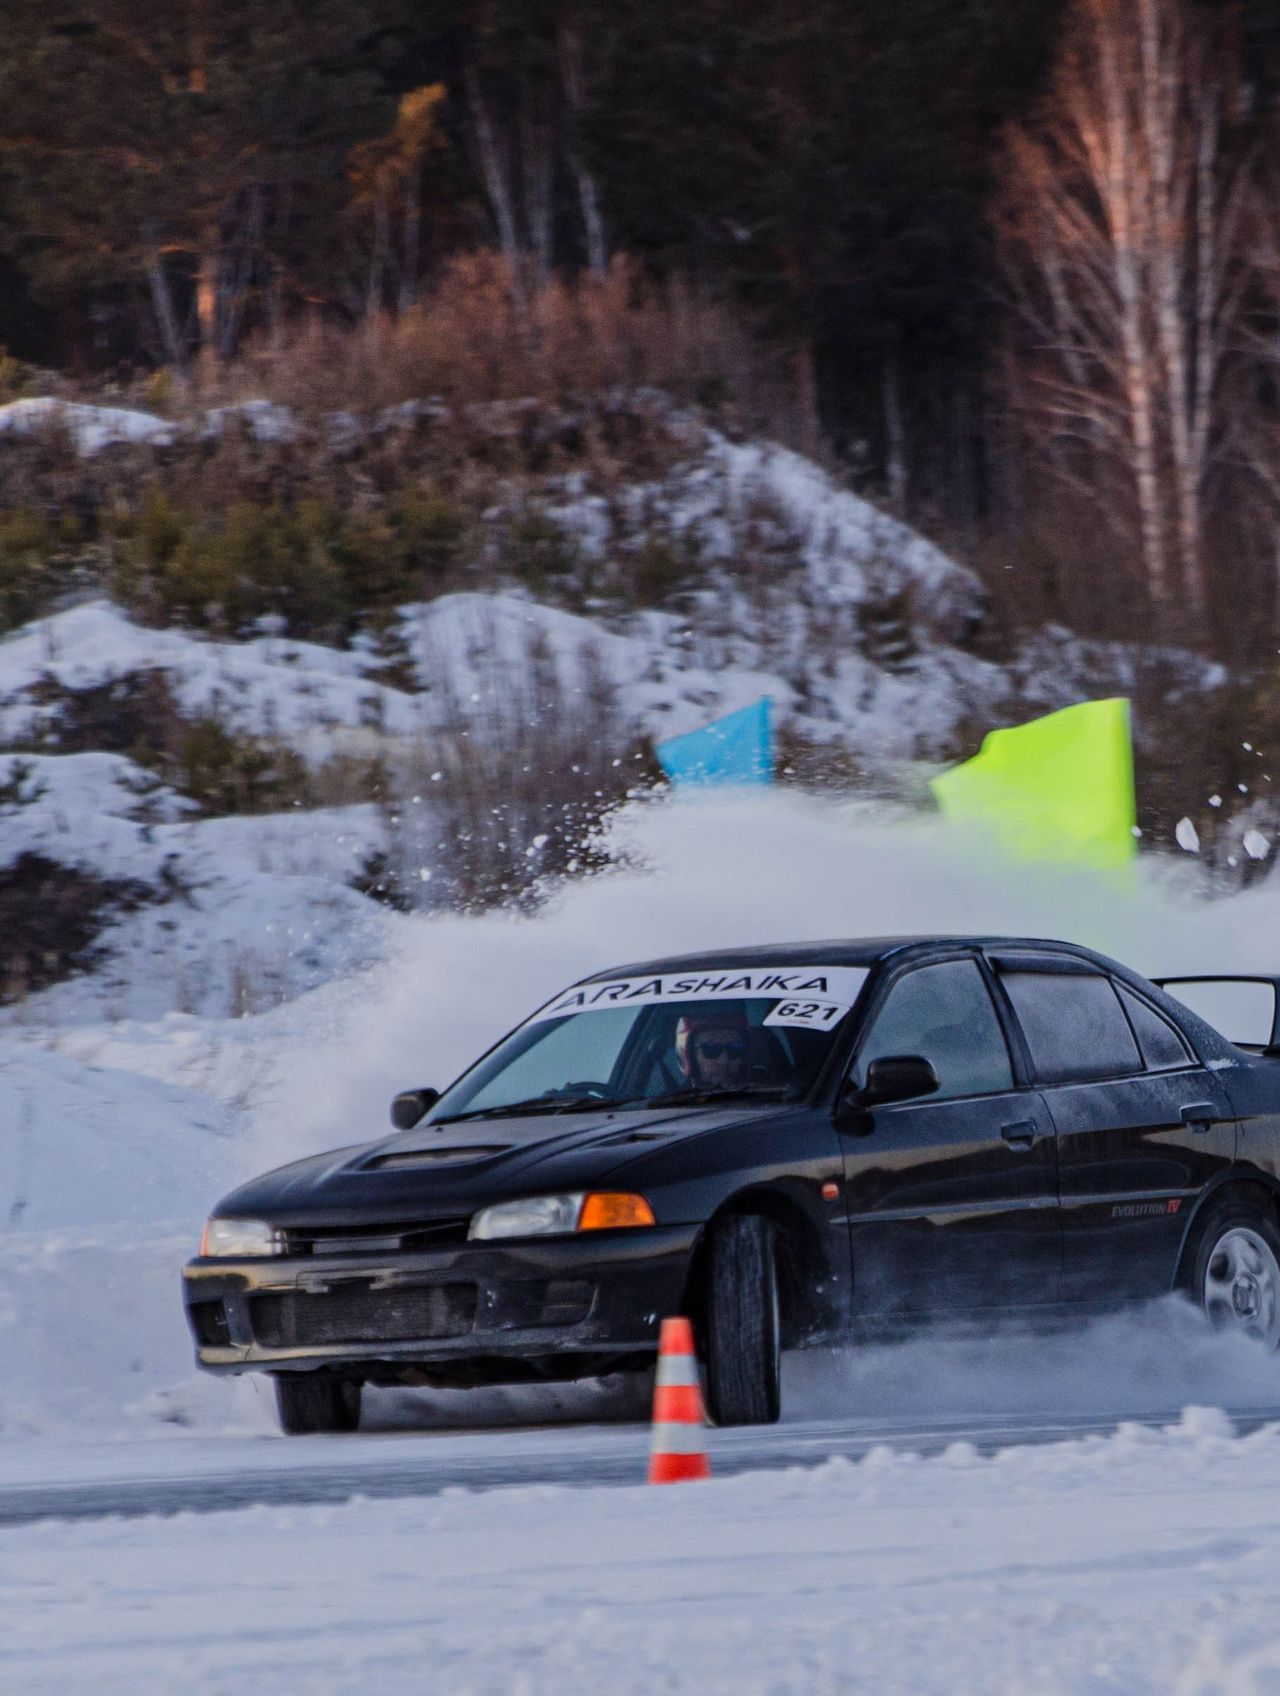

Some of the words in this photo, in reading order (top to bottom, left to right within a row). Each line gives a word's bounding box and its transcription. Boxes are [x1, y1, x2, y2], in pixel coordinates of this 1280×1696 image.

[548, 975, 828, 1013] ARASHAIKA
[777, 1002, 839, 1021] 621
[1111, 1203, 1166, 1217] EVOLUTION
